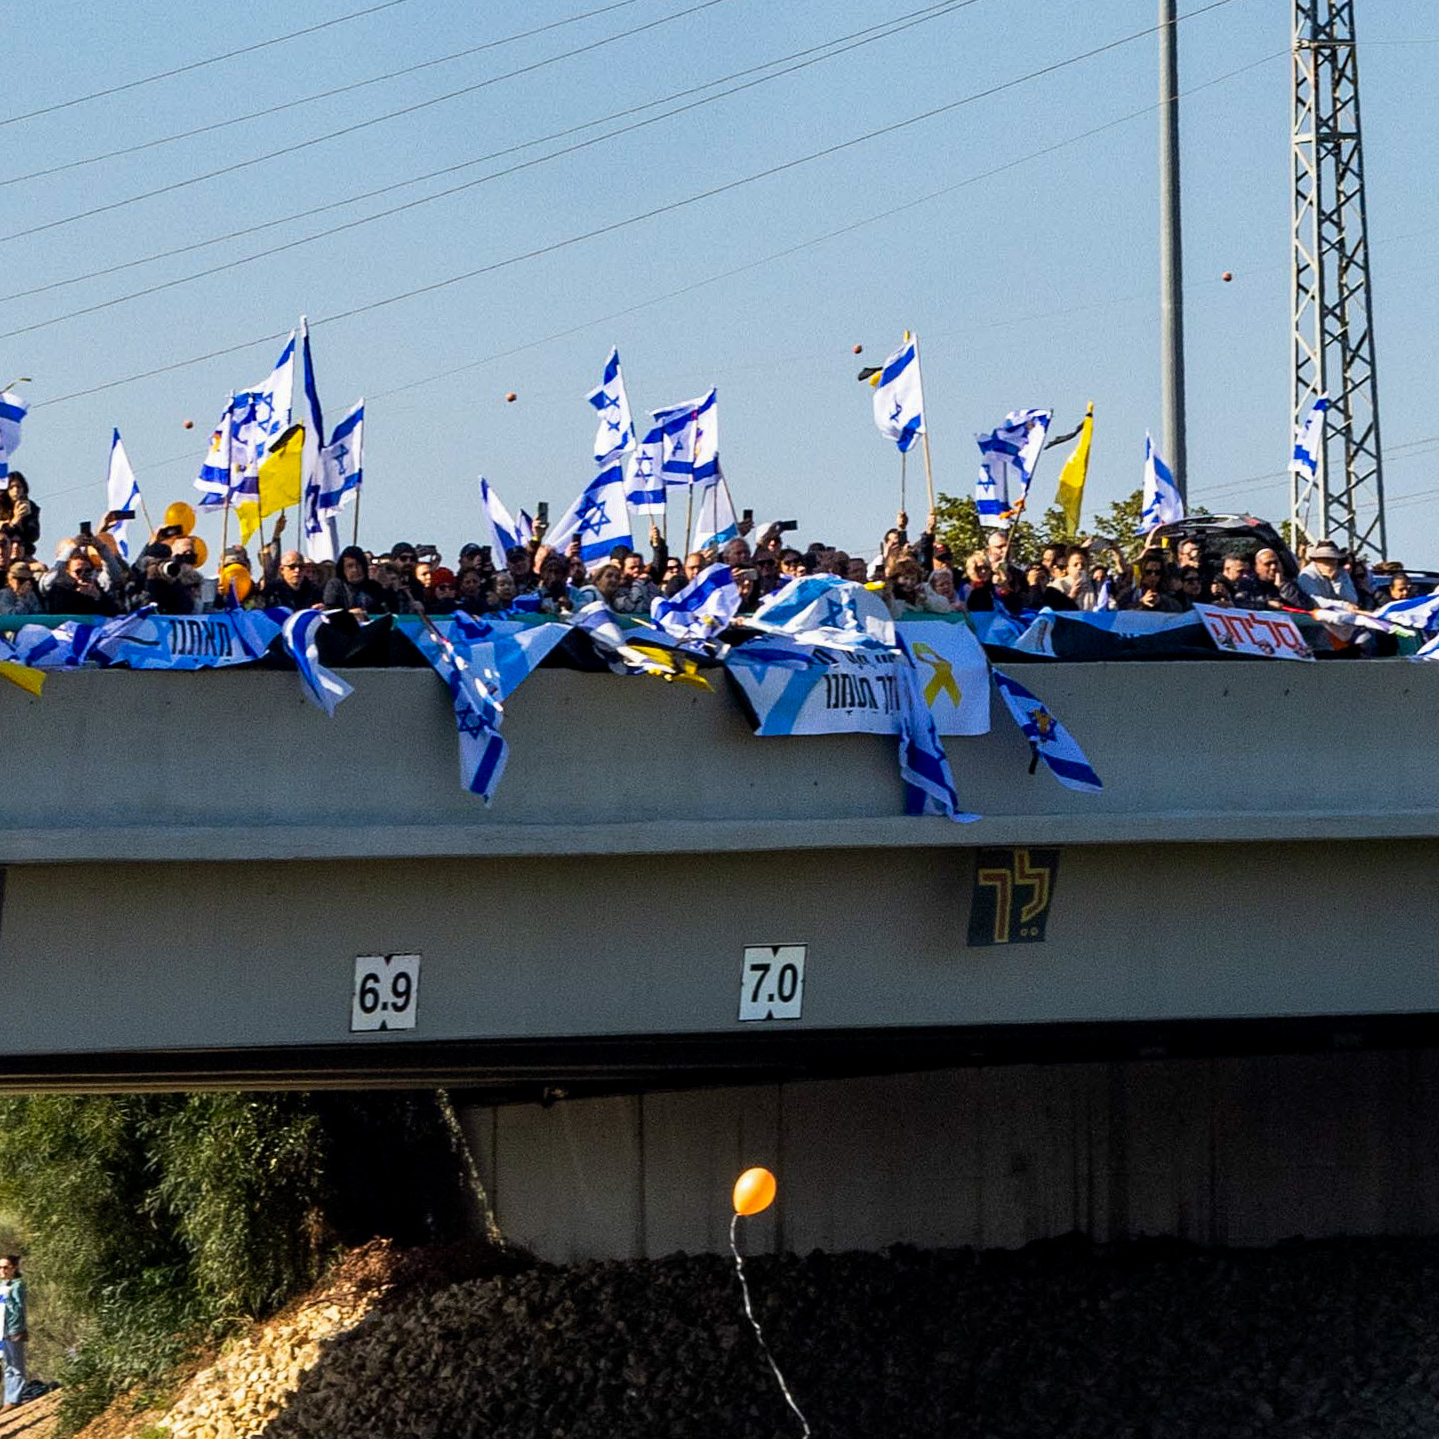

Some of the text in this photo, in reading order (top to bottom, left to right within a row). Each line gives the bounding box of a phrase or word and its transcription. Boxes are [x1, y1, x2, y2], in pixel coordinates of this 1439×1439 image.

[1205, 612, 1300, 649] סליחה
[358, 971, 413, 1014] 6.9
[749, 962, 798, 1004] 7.0
